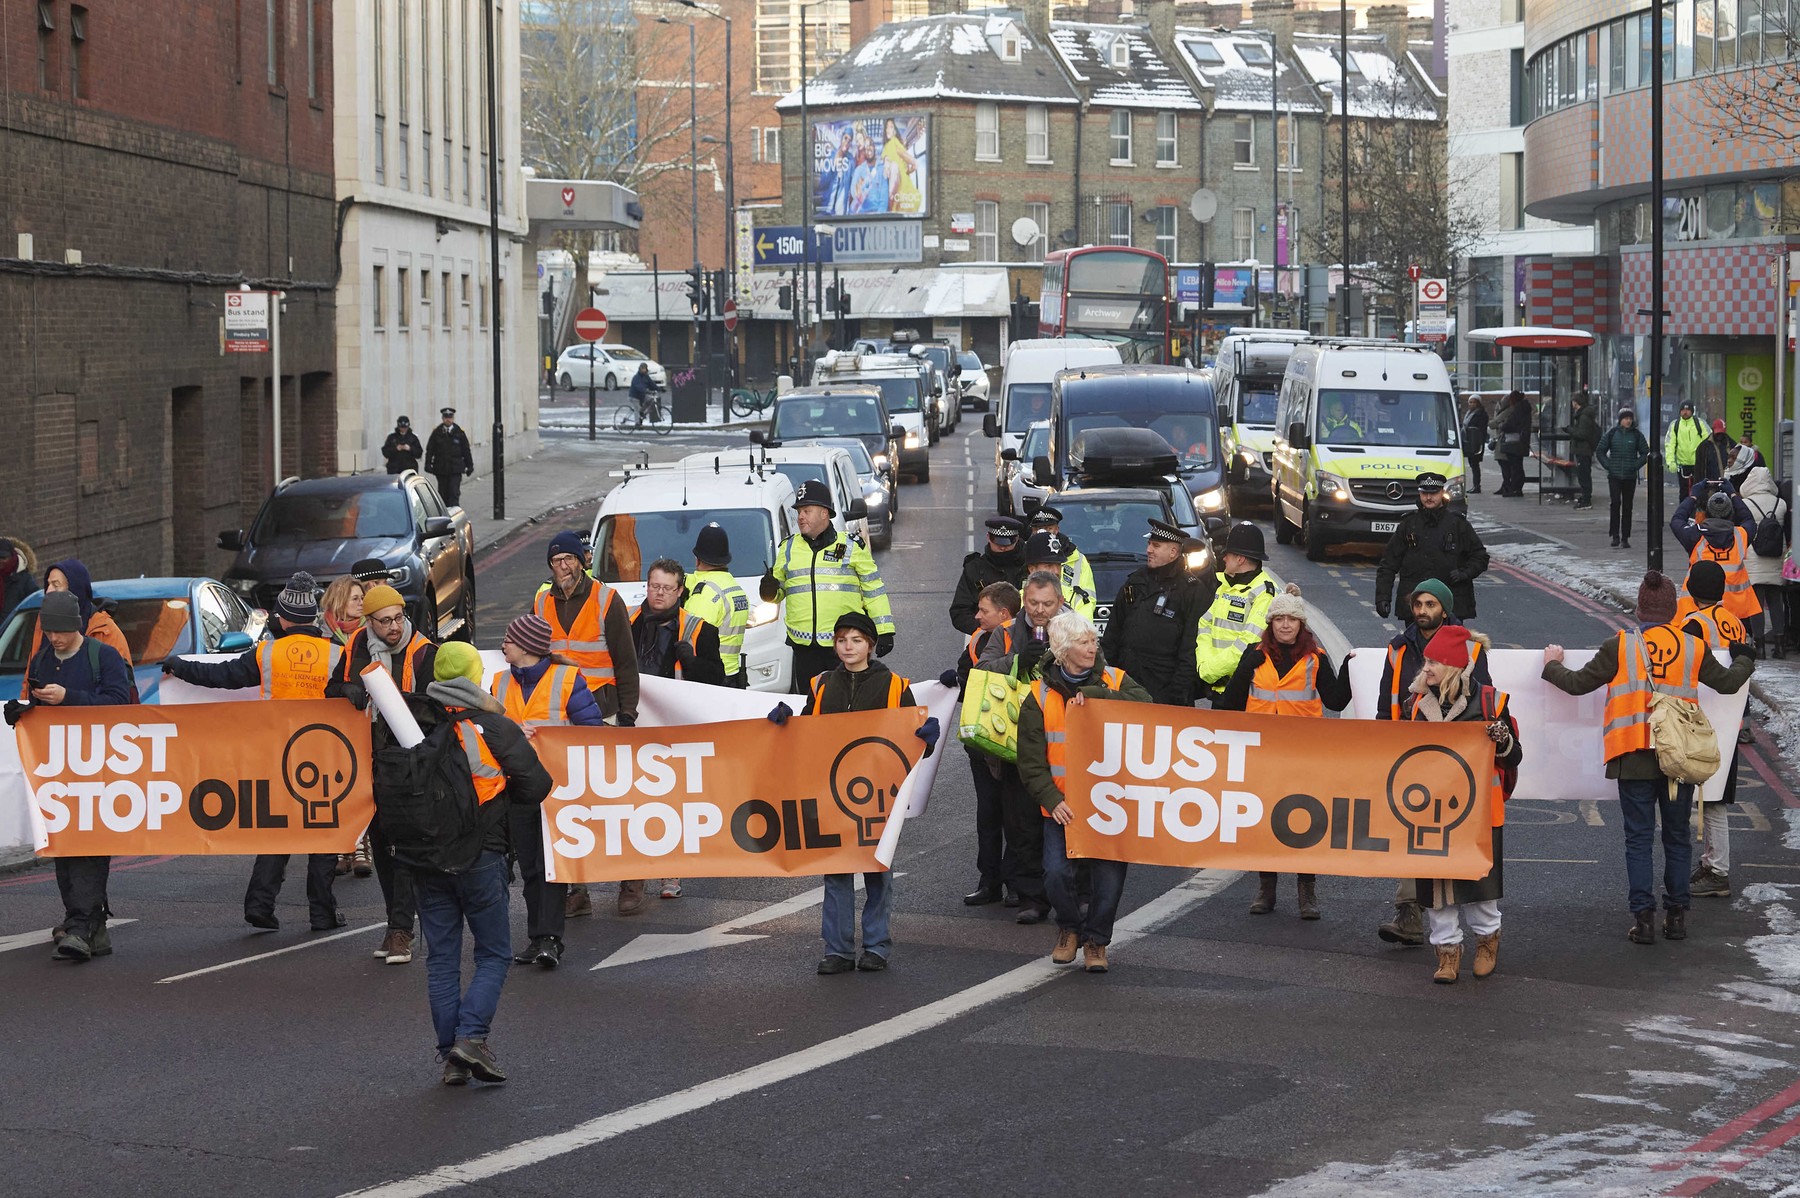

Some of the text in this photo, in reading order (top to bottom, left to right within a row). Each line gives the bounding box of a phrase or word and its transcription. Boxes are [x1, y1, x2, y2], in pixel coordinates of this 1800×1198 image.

[814, 143, 832, 157] BIG
[814, 157, 849, 173] MOVES
[1678, 196, 1702, 240] 201
[1232, 279, 1248, 287] News
[1084, 308, 1148, 322] Archway 4
[1361, 463, 1425, 472] POLICE
[1375, 523, 1395, 532] BX67
[33, 723, 178, 778] JUST
[551, 741, 716, 800] JUST
[1087, 722, 1261, 782] JUST
[37, 778, 289, 834] STOP OIL
[552, 798, 842, 858] STOP OIL
[1087, 782, 1390, 852] STOP OIL
